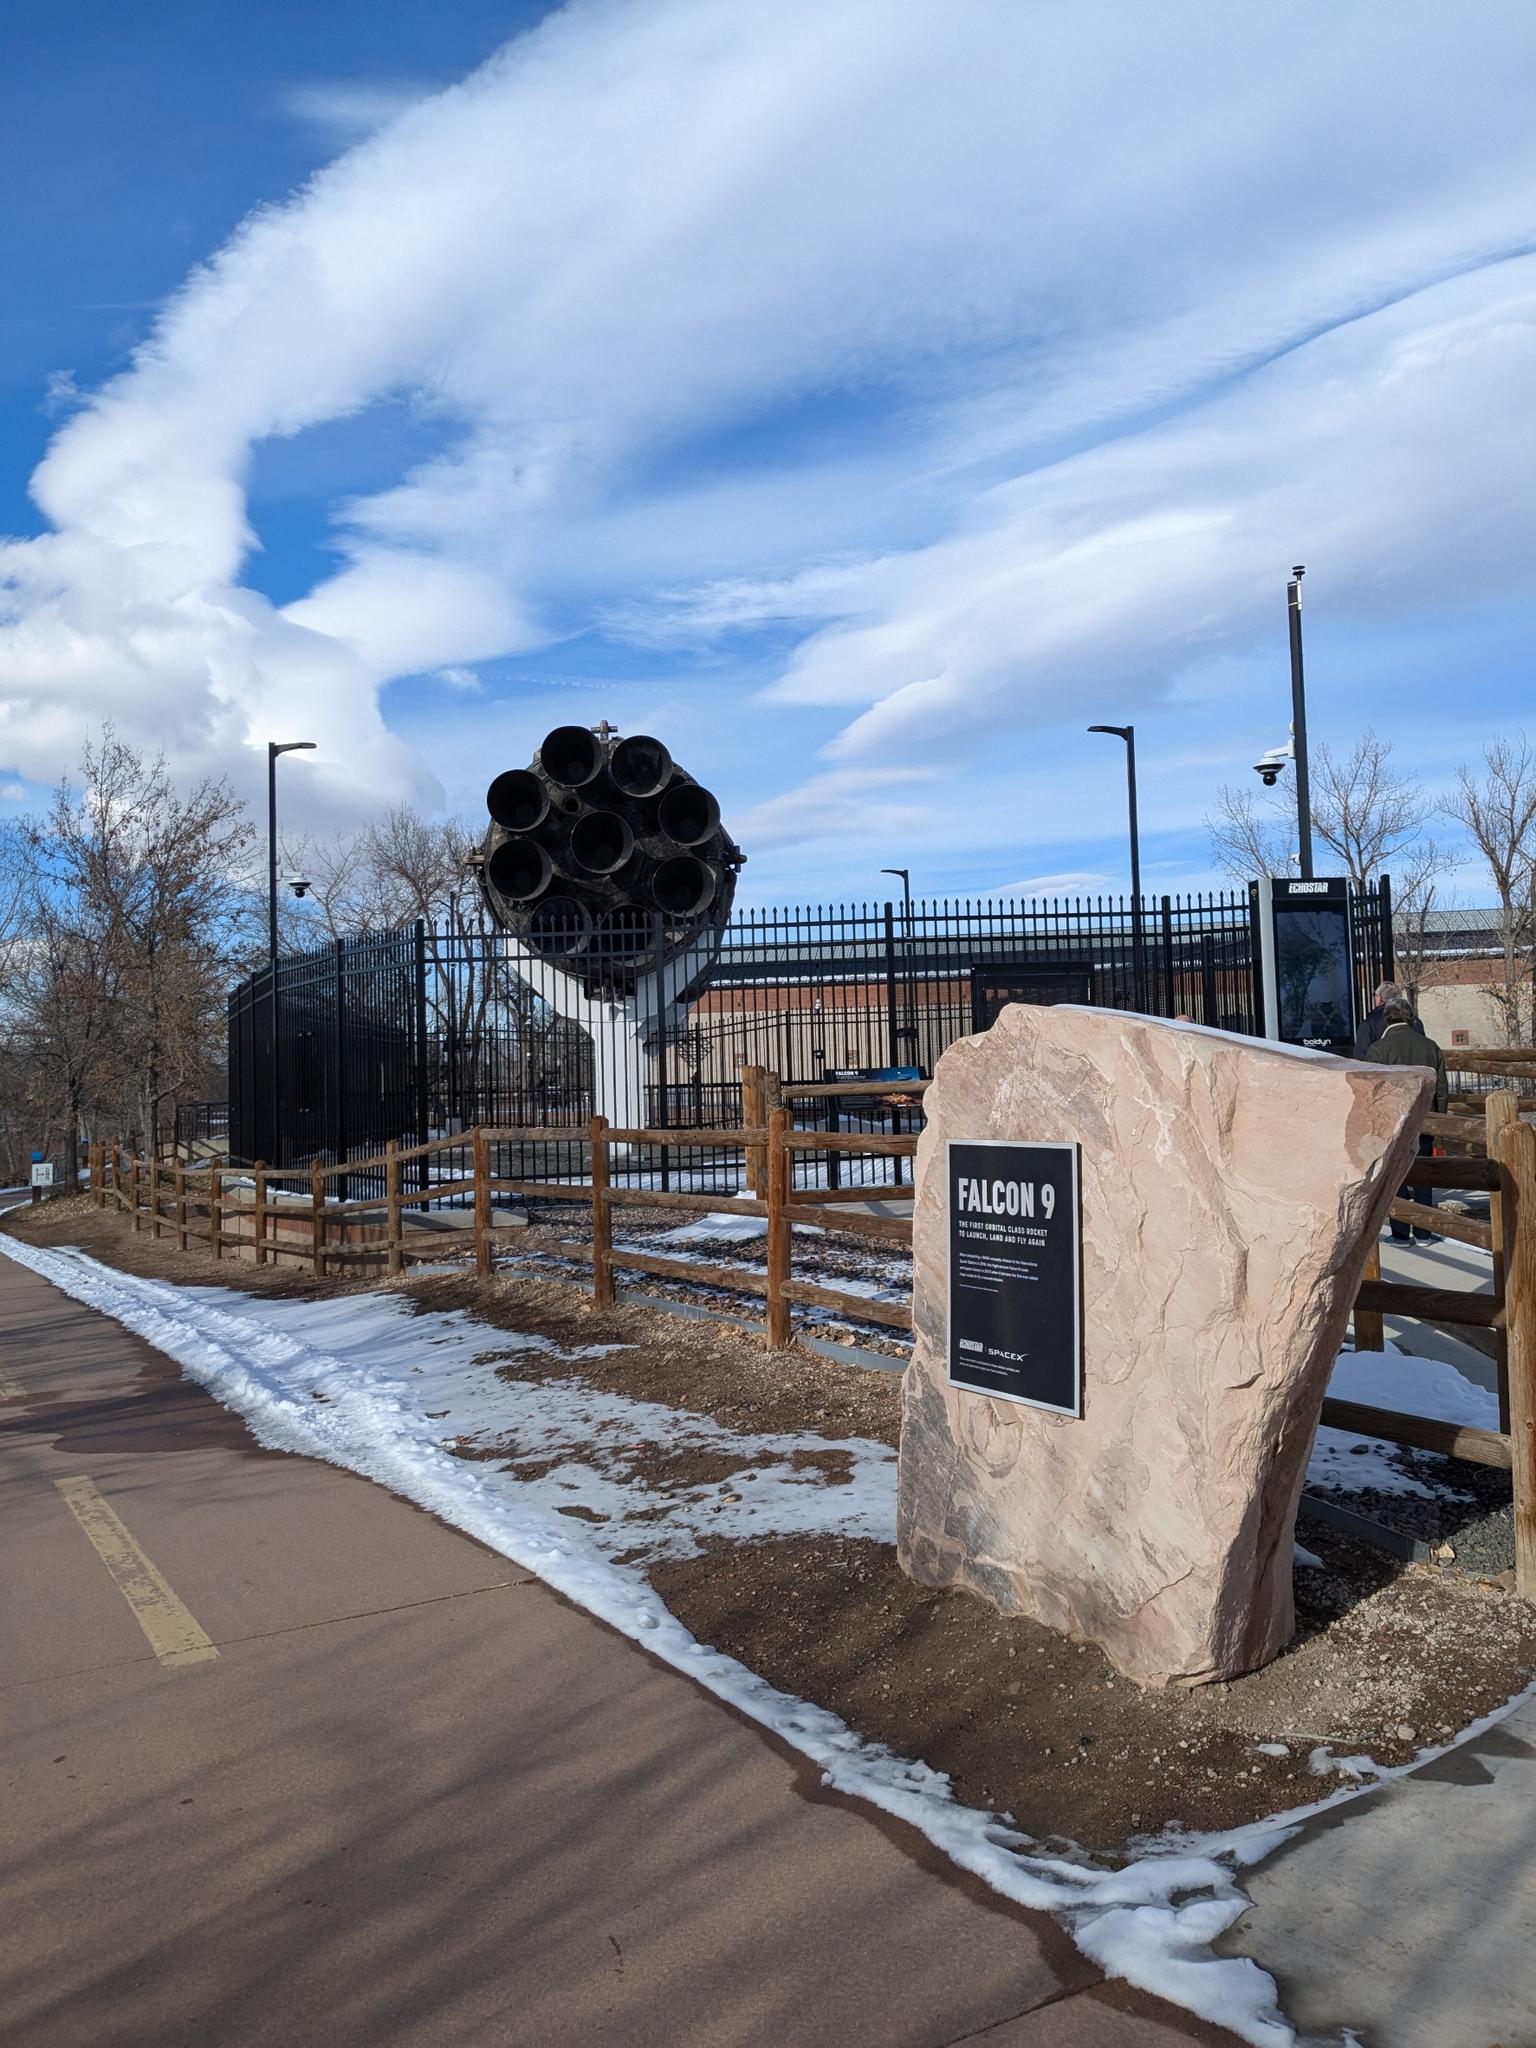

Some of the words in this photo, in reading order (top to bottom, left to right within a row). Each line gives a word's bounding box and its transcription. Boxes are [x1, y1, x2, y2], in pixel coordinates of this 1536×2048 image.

[1288, 882, 1329, 894] ECHOSTAR
[1303, 1038, 1331, 1047] boldyn
[958, 1177, 1035, 1218] FALCON
[1041, 1183, 1056, 1220] 9
[958, 1220, 968, 1229] THE
[969, 1221, 984, 1231] FIRST
[985, 1223, 1007, 1233] ORBITAL
[1007, 1225, 1025, 1235] CLASS
[1026, 1227, 1048, 1237] ROCKET
[958, 1229, 966, 1238] TO
[966, 1230, 988, 1241] LAUNCH,
[989, 1233, 1003, 1242] LAND
[1004, 1235, 1016, 1244] AND
[1017, 1236, 1027, 1245] FLY
[1028, 1238, 1046, 1247] AGAIN
[988, 1347, 1030, 1362] SPACEX
